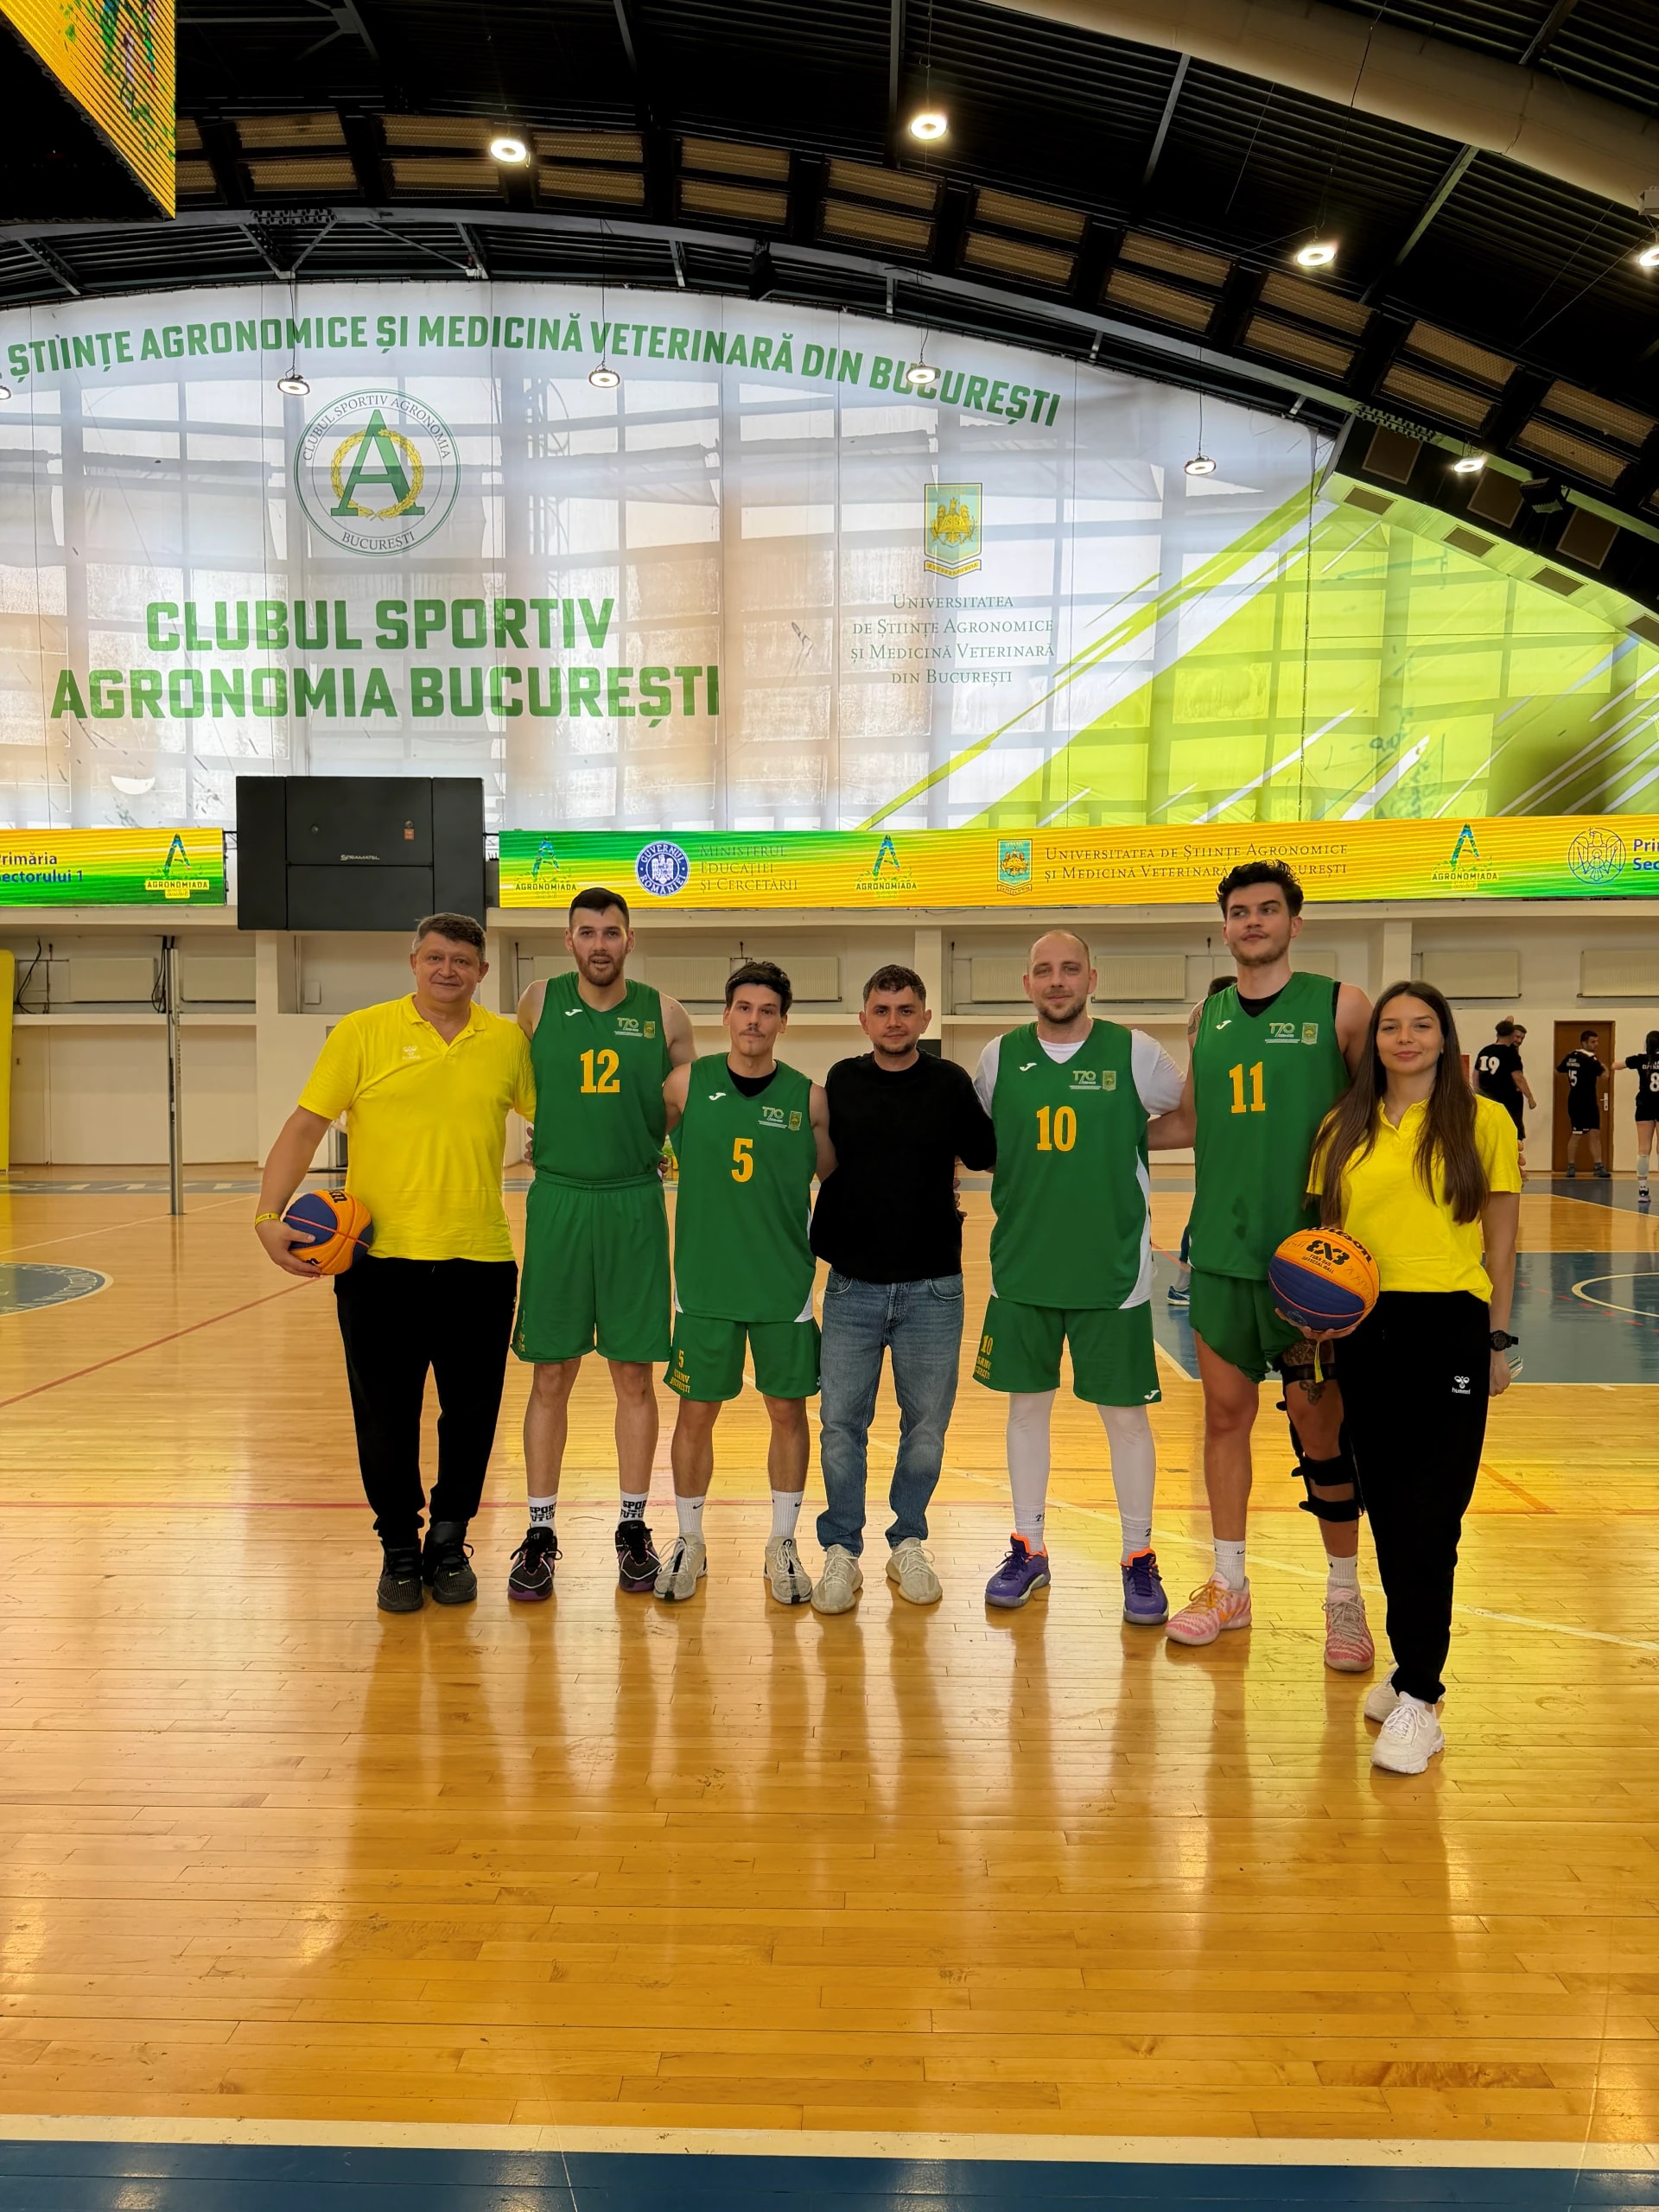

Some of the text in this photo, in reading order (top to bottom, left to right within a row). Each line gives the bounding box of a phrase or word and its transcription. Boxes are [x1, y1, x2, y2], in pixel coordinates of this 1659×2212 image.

[8, 330, 134, 383] ȘTIINȚE
[141, 316, 367, 360] AGRONOMICE
[376, 316, 408, 354] ȘI
[419, 313, 582, 353] MEDICINĂ
[590, 321, 793, 373] VETERINARĂ
[801, 343, 863, 385] DIN
[303, 395, 451, 461] CLUBUL SPORTIV AGRONOMIA
[146, 598, 615, 652] CLUBUL SPORTIV
[50, 665, 720, 728] AGRONOMIA BUCUREȘTI
[0, 852, 58, 865] rimăria
[641, 843, 683, 864] GUVERNUL
[0, 869, 83, 882] ectorului 1
[147, 880, 208, 889] AGRONOMIADA
[516, 882, 576, 891] AGRONOMIADA
[580, 1048, 620, 1094] 12
[1479, 1055, 1500, 1075] 19
[1229, 1061, 1266, 1114] 11
[1036, 1105, 1077, 1152] 10
[731, 1138, 753, 1183] 5
[678, 1350, 684, 1368] 5
[981, 1335, 994, 1356] 10
